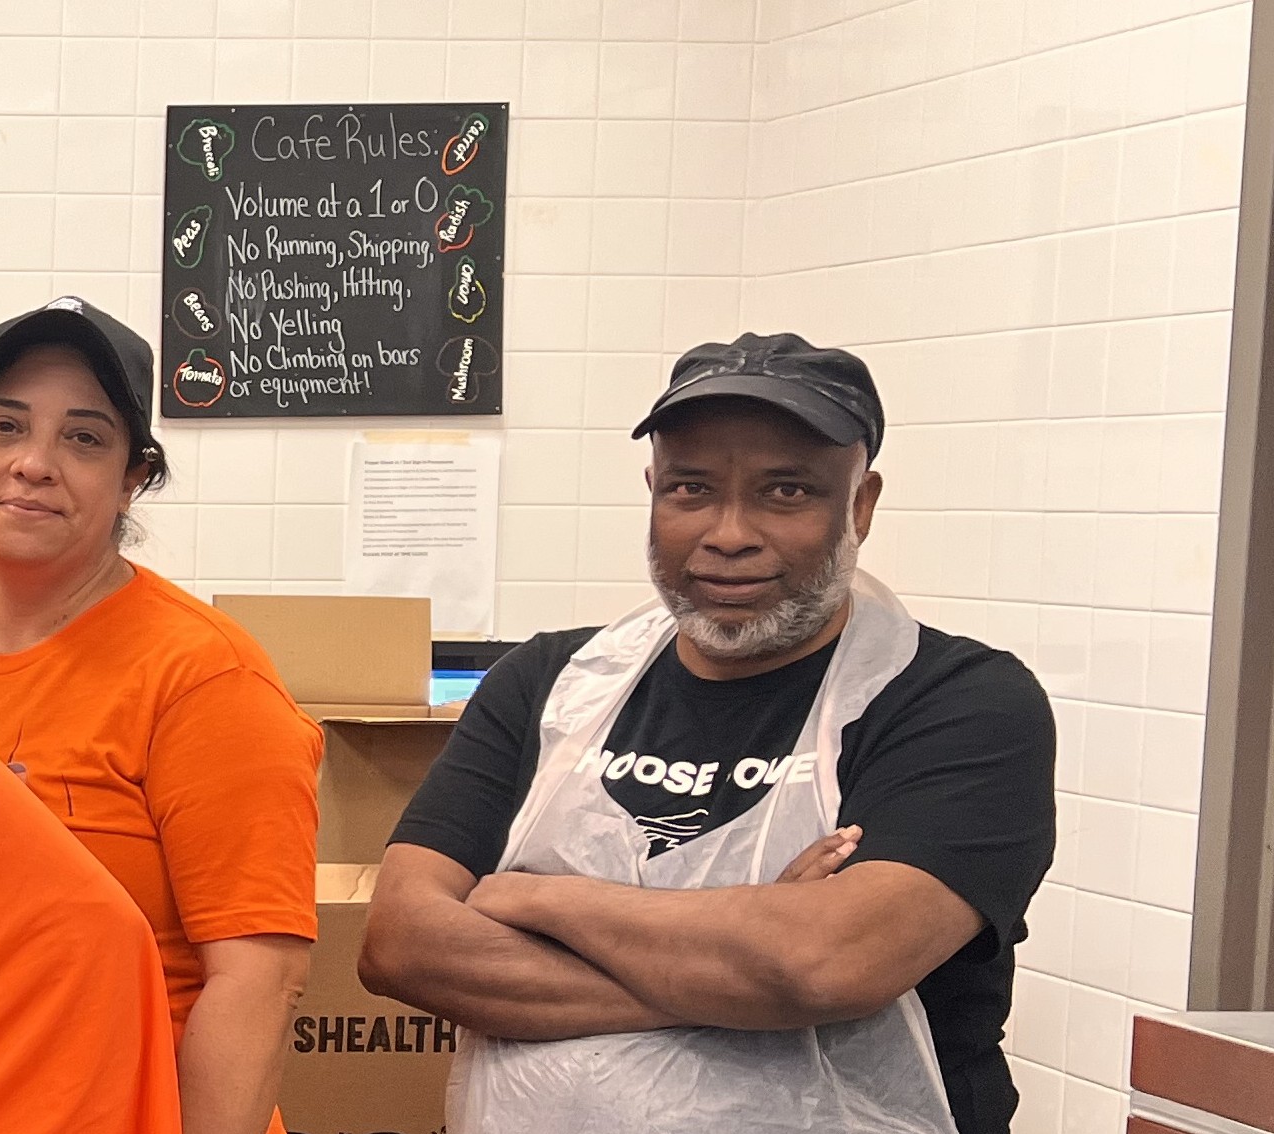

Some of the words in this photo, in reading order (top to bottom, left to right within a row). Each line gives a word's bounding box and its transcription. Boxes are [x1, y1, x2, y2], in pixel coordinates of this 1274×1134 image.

[199, 125, 220, 177] Broccoli
[251, 114, 336, 162] Cafe
[337, 112, 440, 164] Rules:
[225, 181, 312, 220] Volume
[317, 181, 342, 218] at
[348, 196, 363, 218] a
[369, 179, 386, 218] 1
[391, 197, 410, 214] or
[439, 199, 471, 242] Radish
[227, 229, 259, 267] No
[265, 225, 345, 268] Running,
[348, 230, 435, 268] Skipping,
[227, 270, 257, 300] No
[261, 269, 339, 312] Pushing,
[341, 266, 412, 312] Hitting,
[183, 292, 215, 333] Beans
[229, 309, 262, 344] No
[269, 308, 346, 353] Yelling
[179, 367, 223, 386] Tomato
[229, 348, 262, 377] No
[266, 345, 348, 379] Climbing
[351, 354, 374, 369] on
[377, 341, 421, 366] bars
[451, 338, 474, 401] Mushroom
[229, 379, 253, 398] or
[260, 371, 374, 408] equipment!
[573, 748, 719, 797] HOOSE
[725, 751, 819, 790] OVE
[293, 1015, 458, 1054] SHEALTH
